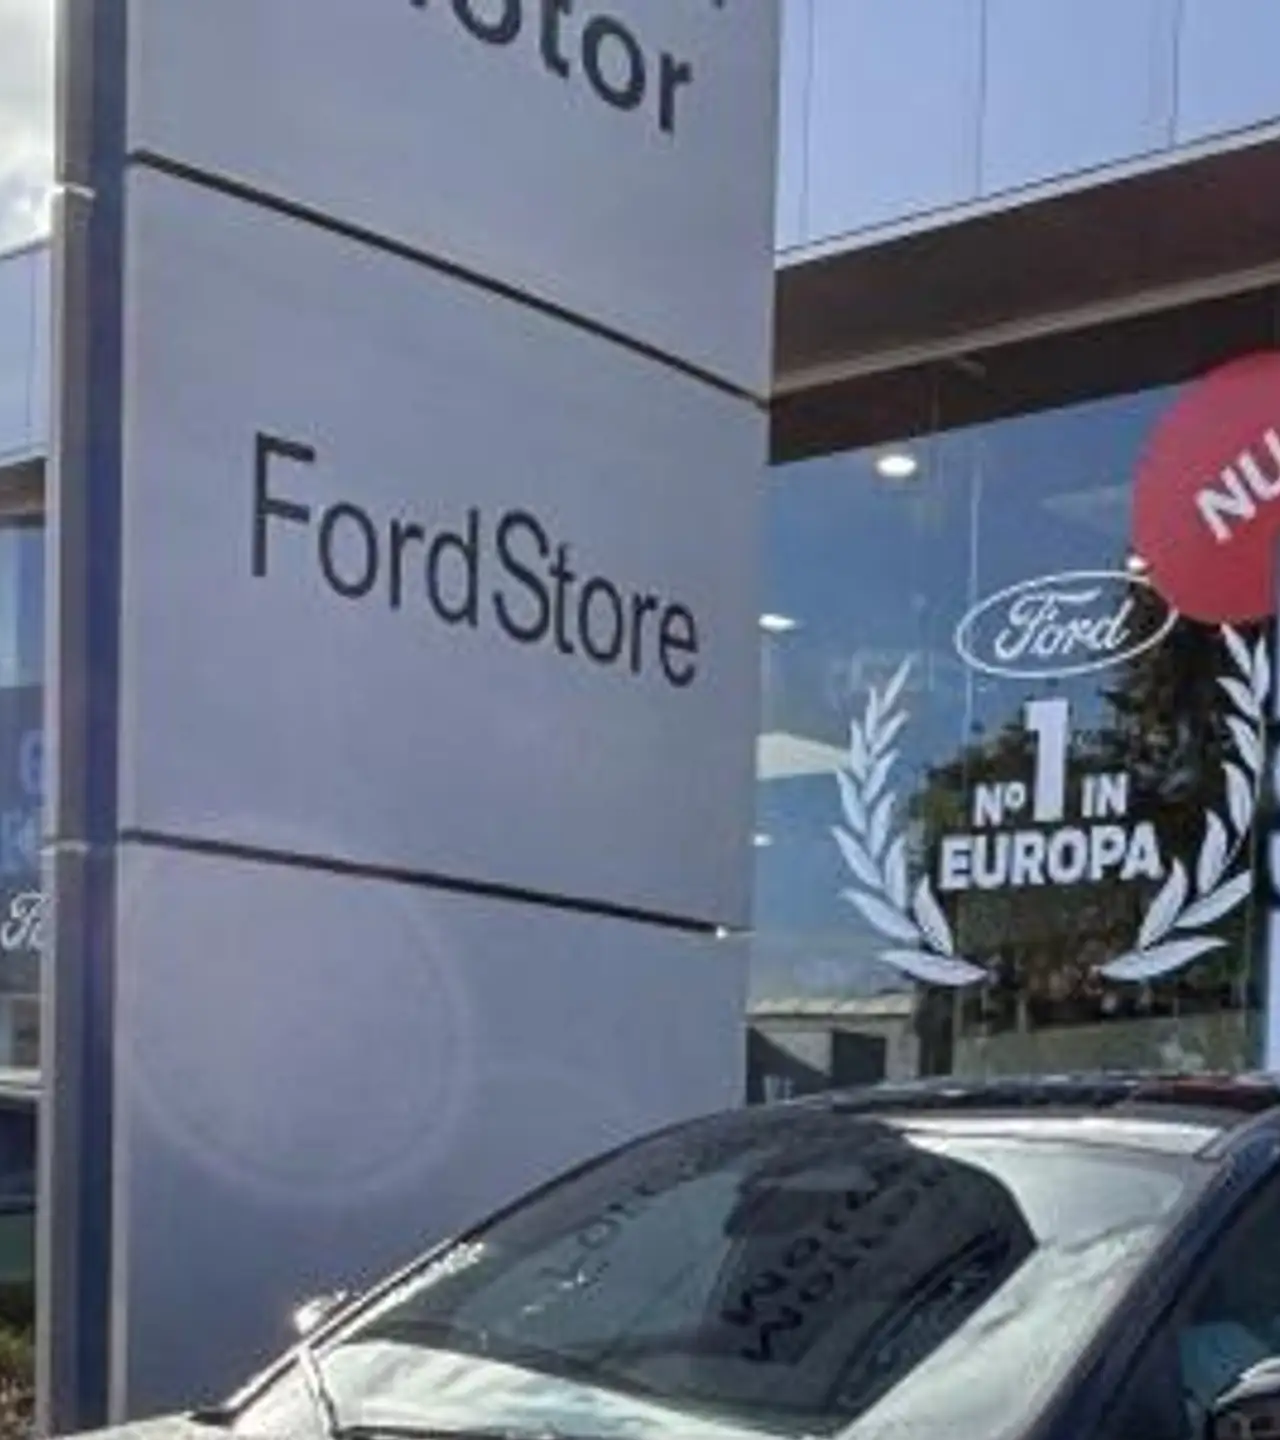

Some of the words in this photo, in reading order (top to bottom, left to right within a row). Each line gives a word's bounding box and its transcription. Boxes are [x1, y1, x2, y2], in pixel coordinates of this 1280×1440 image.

[408, 0, 695, 134] tor
[251, 431, 699, 687] FordStore
[993, 588, 1135, 661] Ford
[1027, 698, 1069, 822] 1
[1080, 773, 1130, 818] IN
[937, 821, 1165, 891] EUROPA
